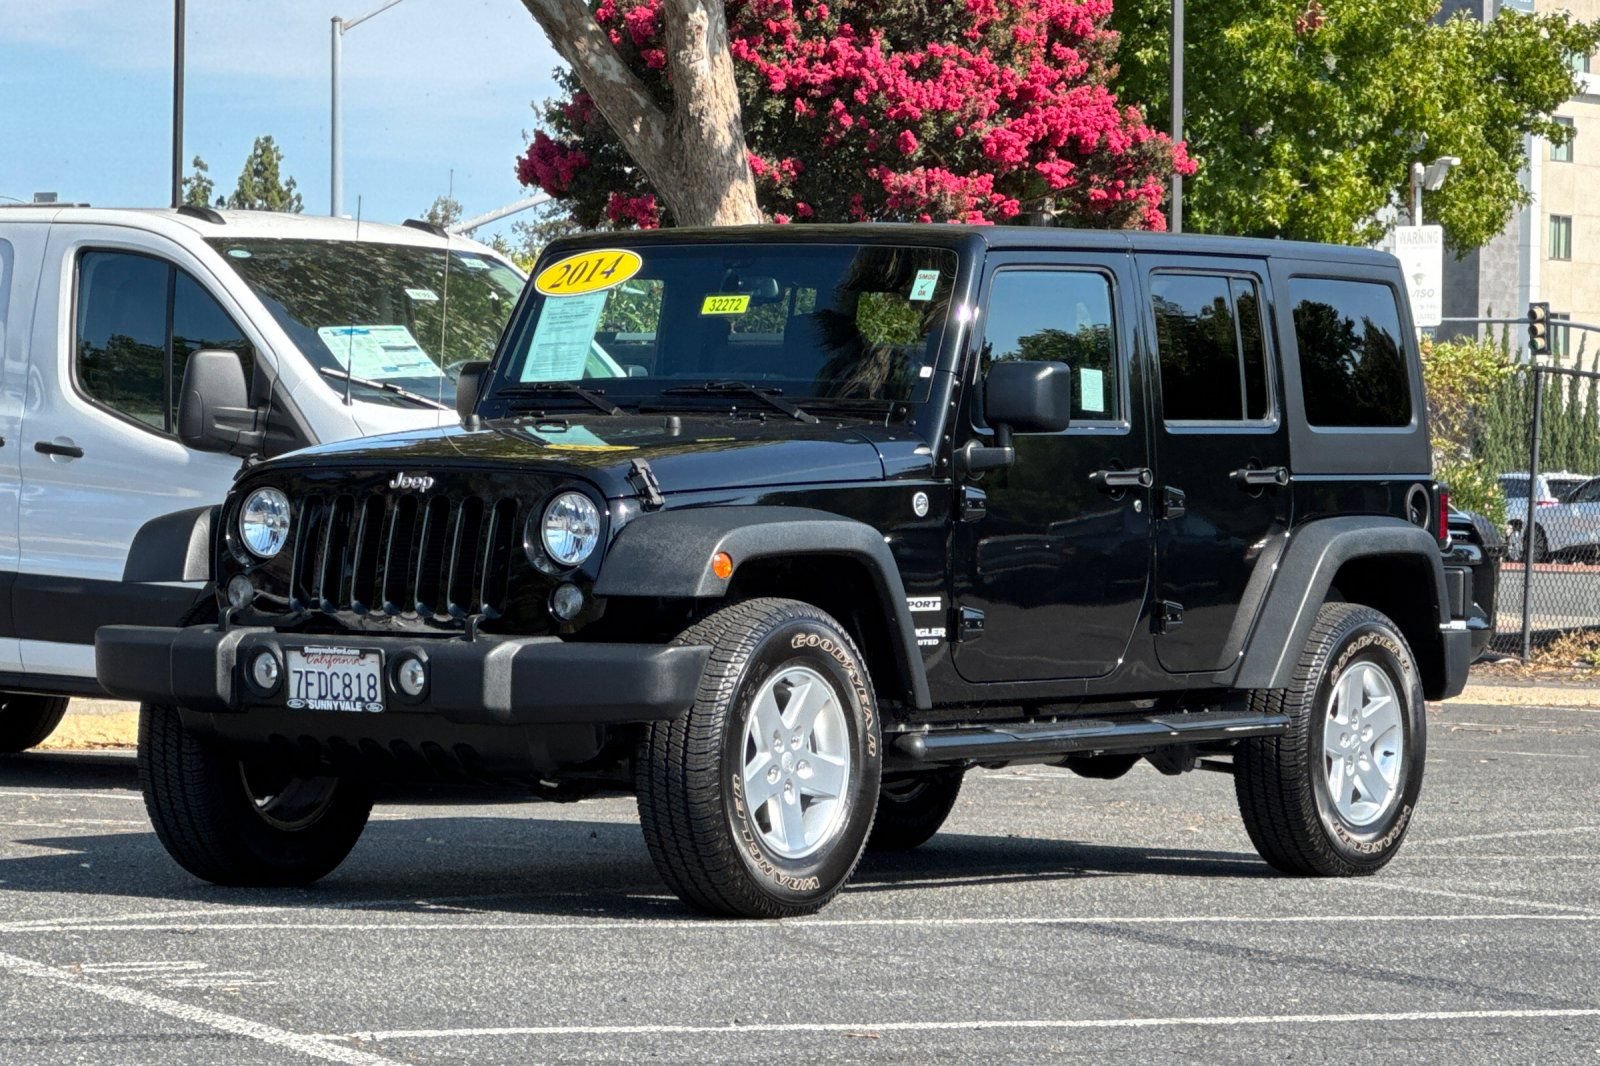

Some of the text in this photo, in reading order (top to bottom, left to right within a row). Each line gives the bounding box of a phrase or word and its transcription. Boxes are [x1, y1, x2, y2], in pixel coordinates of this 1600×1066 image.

[1399, 231, 1439, 244] WARNING
[548, 254, 626, 290] 2014
[1411, 288, 1435, 298] VISO
[708, 298, 742, 312] 32272
[389, 471, 434, 493] Jeep
[908, 600, 937, 608] PORT
[915, 627, 946, 638] GLER
[305, 653, 364, 669] California
[1331, 632, 1411, 686] GOODYEAR
[292, 670, 378, 702] 7FDC818
[791, 632, 877, 757] GOODYEAR
[308, 699, 362, 711] SUNNYVALE
[732, 773, 821, 891] WRANGLER
